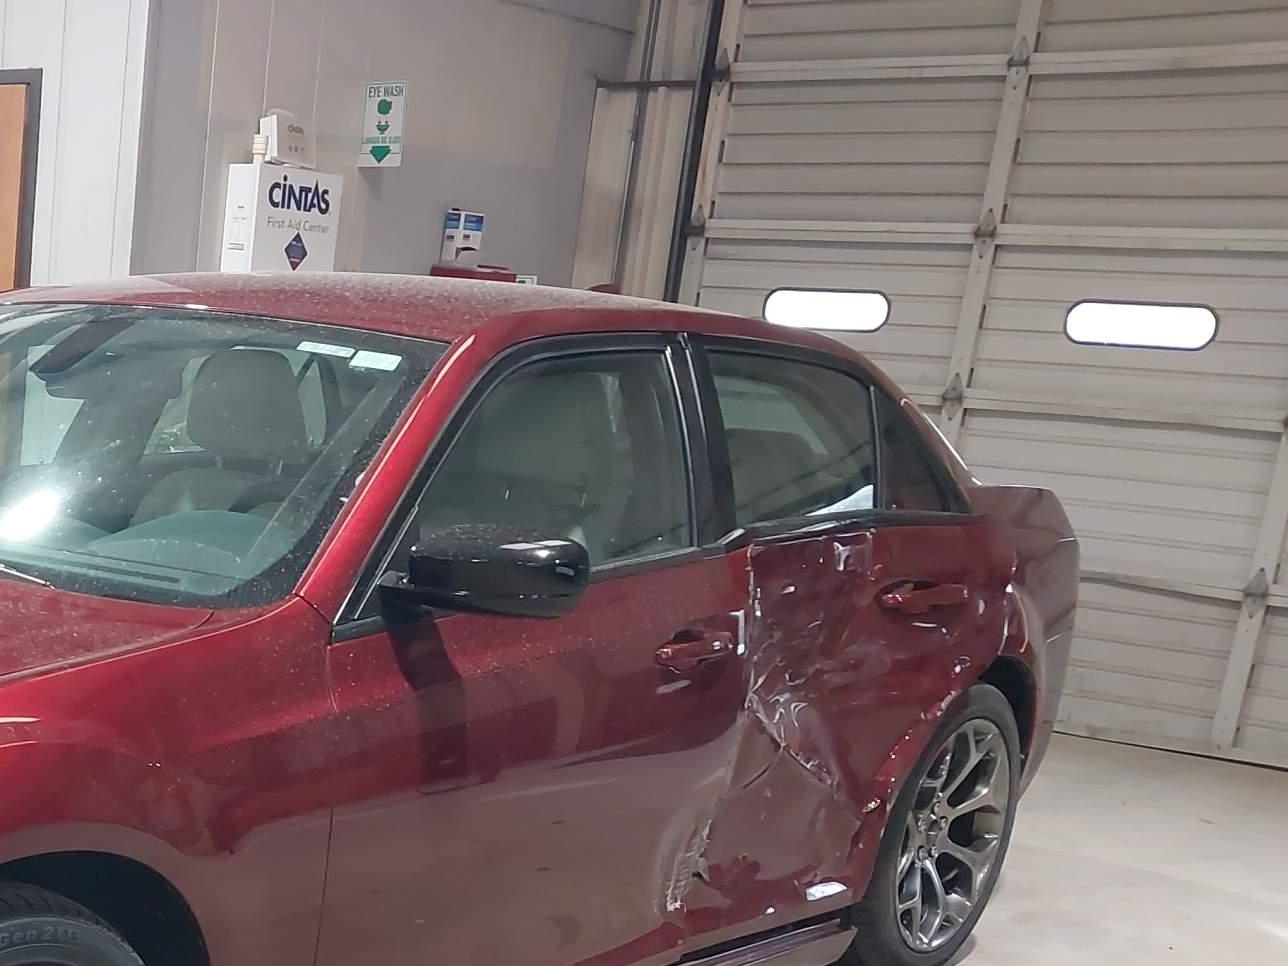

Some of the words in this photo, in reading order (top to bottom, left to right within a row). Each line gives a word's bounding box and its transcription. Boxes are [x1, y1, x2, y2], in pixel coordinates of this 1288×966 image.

[368, 86, 382, 98] EYE
[383, 85, 404, 97] WASH
[268, 174, 330, 215] CINTAS
[267, 215, 285, 229] First
[287, 218, 301, 231] Aid
[303, 220, 330, 233] Center
[42, 925, 57, 941] 2
